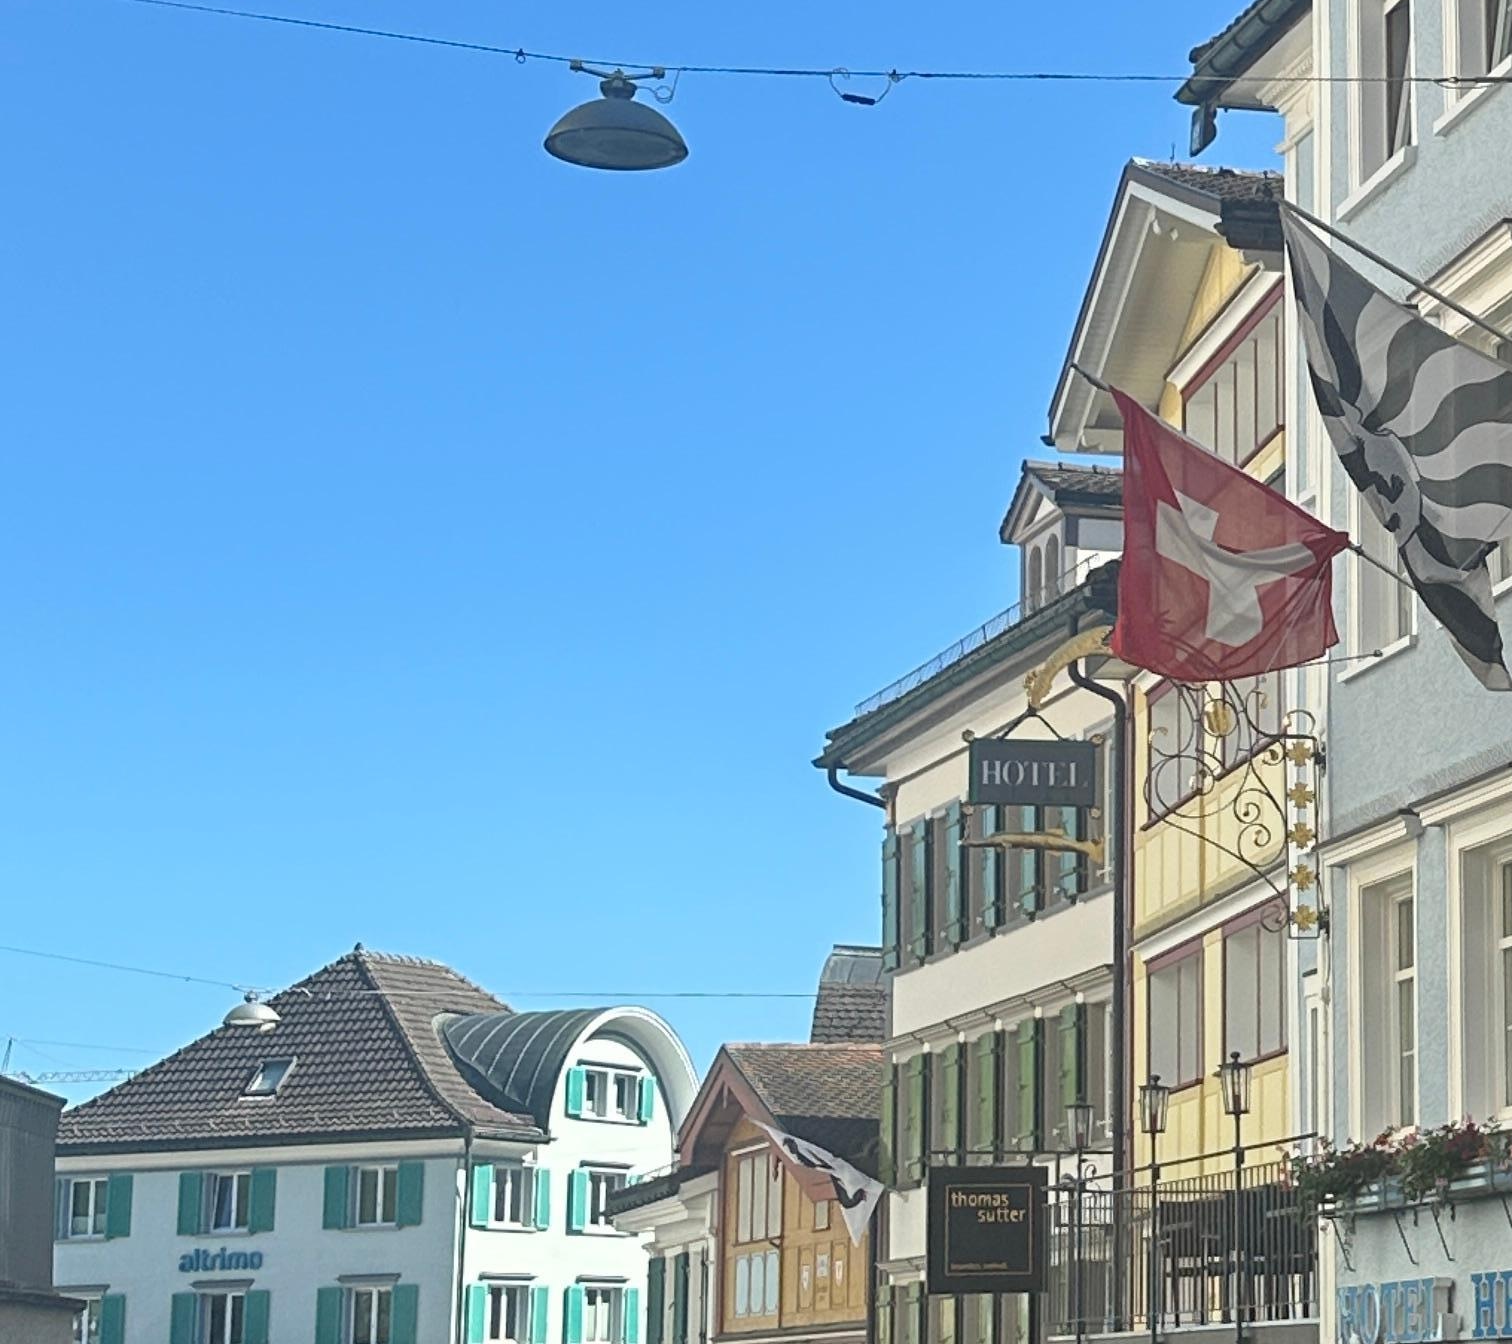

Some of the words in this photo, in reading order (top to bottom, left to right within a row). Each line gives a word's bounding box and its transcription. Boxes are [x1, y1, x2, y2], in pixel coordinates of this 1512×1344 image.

[982, 759, 1089, 787] HOTEL
[951, 1191, 1009, 1207] thomas
[978, 1207, 1026, 1223] sutter
[178, 1246, 263, 1273] altrimo
